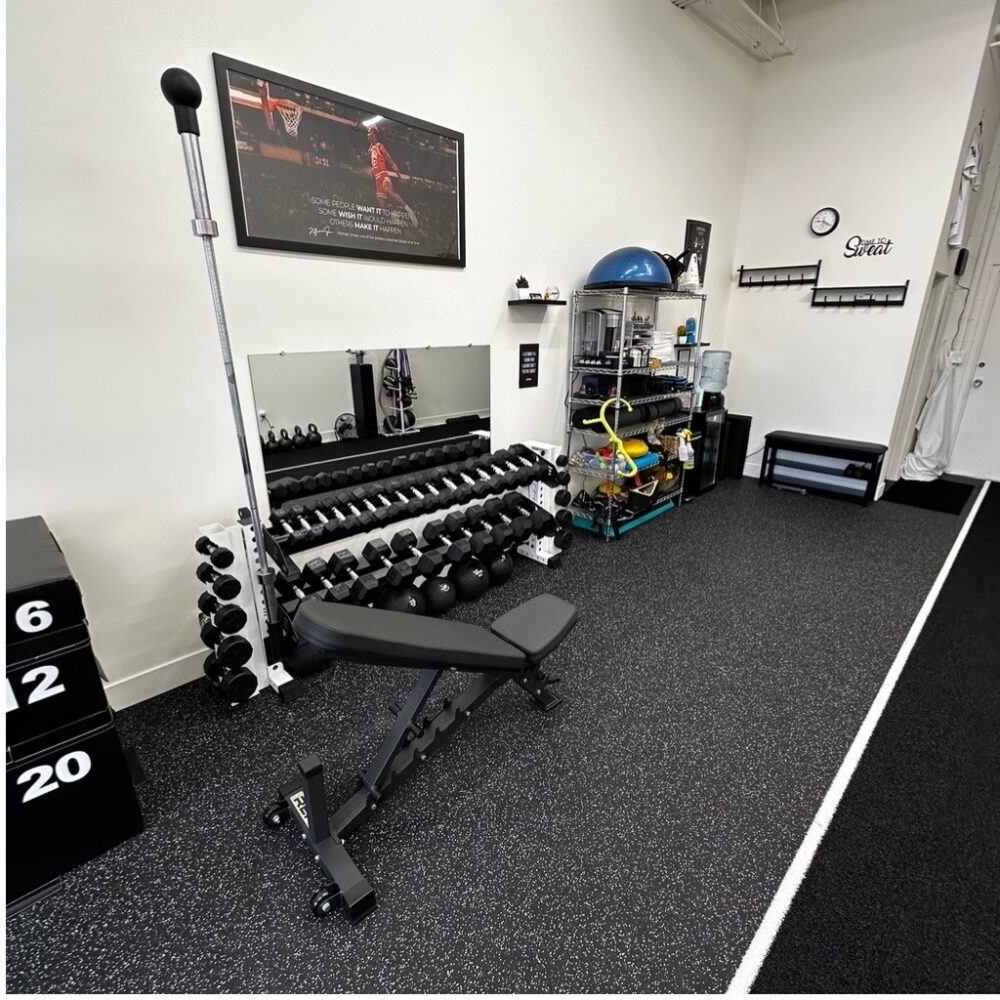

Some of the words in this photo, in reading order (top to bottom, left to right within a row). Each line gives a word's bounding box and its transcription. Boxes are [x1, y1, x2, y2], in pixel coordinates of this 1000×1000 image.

[311, 196, 331, 207] SOME
[332, 200, 356, 211] PEOPLE
[356, 204, 375, 214] WANT
[376, 207, 382, 215] IT
[318, 207, 338, 217] SOME
[338, 210, 356, 220] WISH
[364, 214, 386, 224] WOULD
[329, 218, 354, 228] OTHERS
[354, 222, 373, 231] MAKE
[373, 224, 379, 232] IT
[843, 235, 893, 258] Sweat
[15, 600, 53, 633] 6
[16, 750, 92, 804] 20
